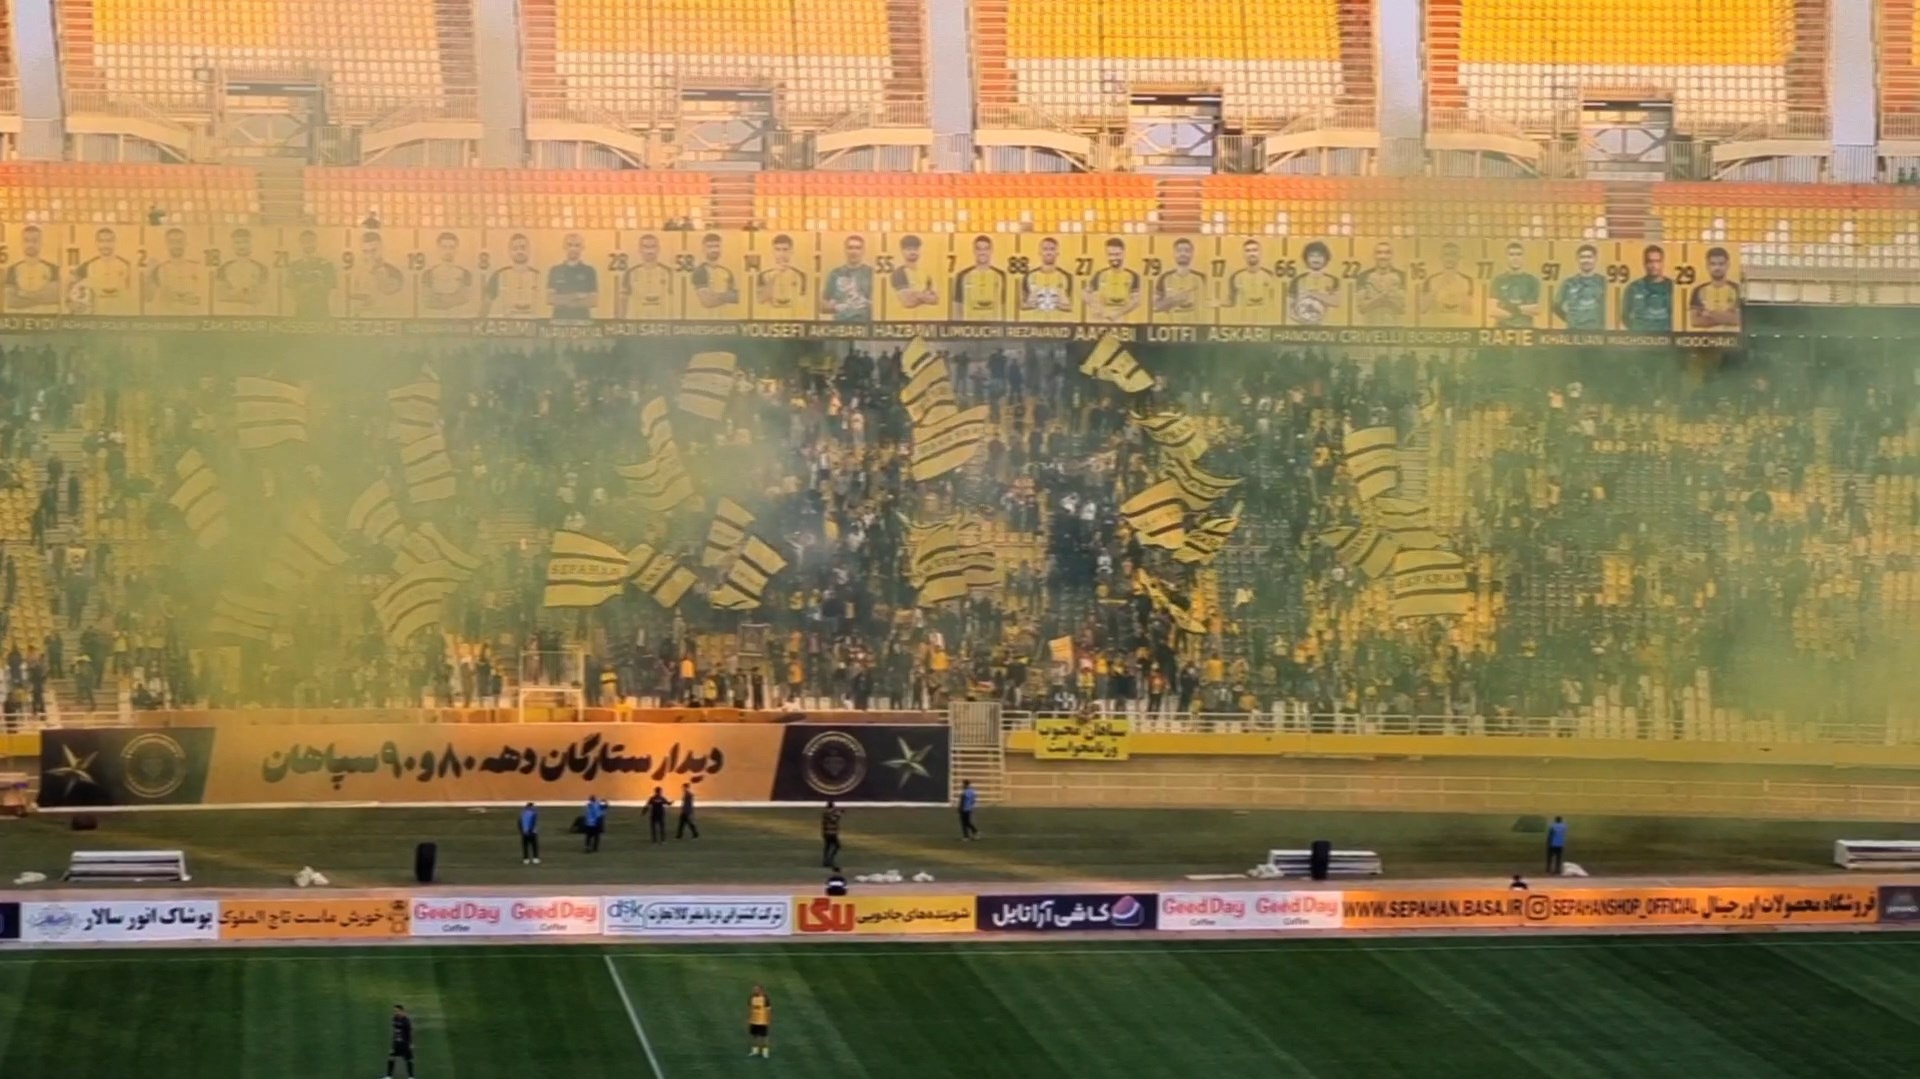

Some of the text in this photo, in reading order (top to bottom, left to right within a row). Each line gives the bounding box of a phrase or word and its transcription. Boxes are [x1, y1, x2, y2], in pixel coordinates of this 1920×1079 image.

[66, 247, 80, 265] 11
[138, 249, 148, 267] 2
[341, 251, 355, 270] 9
[407, 252, 426, 271] 19
[478, 251, 490, 270] 8
[608, 252, 629, 271] 28
[675, 253, 695, 272] 58
[743, 253, 761, 272] 14
[814, 254, 822, 272] 1
[875, 255, 895, 273] 55
[947, 255, 957, 273] 7
[1007, 256, 1030, 274] 88
[1075, 257, 1094, 276] 27
[1143, 258, 1163, 277] 79
[1211, 259, 1226, 278] 17
[1274, 260, 1297, 278] 66
[1342, 261, 1361, 280] 22
[1541, 262, 1561, 281] 97
[1607, 264, 1630, 283] 99
[1674, 266, 1696, 285] 29
[741, 322, 803, 338] YOUSEFI
[809, 324, 866, 338] AKHBARI
[1147, 326, 1197, 342] LOTFI
[1206, 326, 1271, 343] ASKARI
[1478, 328, 1534, 346] RAFIE
[479, 745, 537, 775] دهه
[539, 732, 651, 781] ستارگان
[651, 742, 724, 784] دیدار
[262, 743, 379, 790] سپاهان
[463, 903, 500, 924] Day
[560, 902, 598, 923] Day
[1210, 897, 1246, 918] Day
[1303, 896, 1338, 917] Day
[1551, 897, 1699, 919] SEPAHANSHOP_OFFICIAL
[1761, 894, 1821, 919] محصولات
[1824, 891, 1876, 918] فروشگاه
[83, 906, 124, 931] سالار
[159, 906, 213, 930] پوشاک
[268, 910, 291, 930] تاج
[1054, 902, 1110, 927] کاشی
